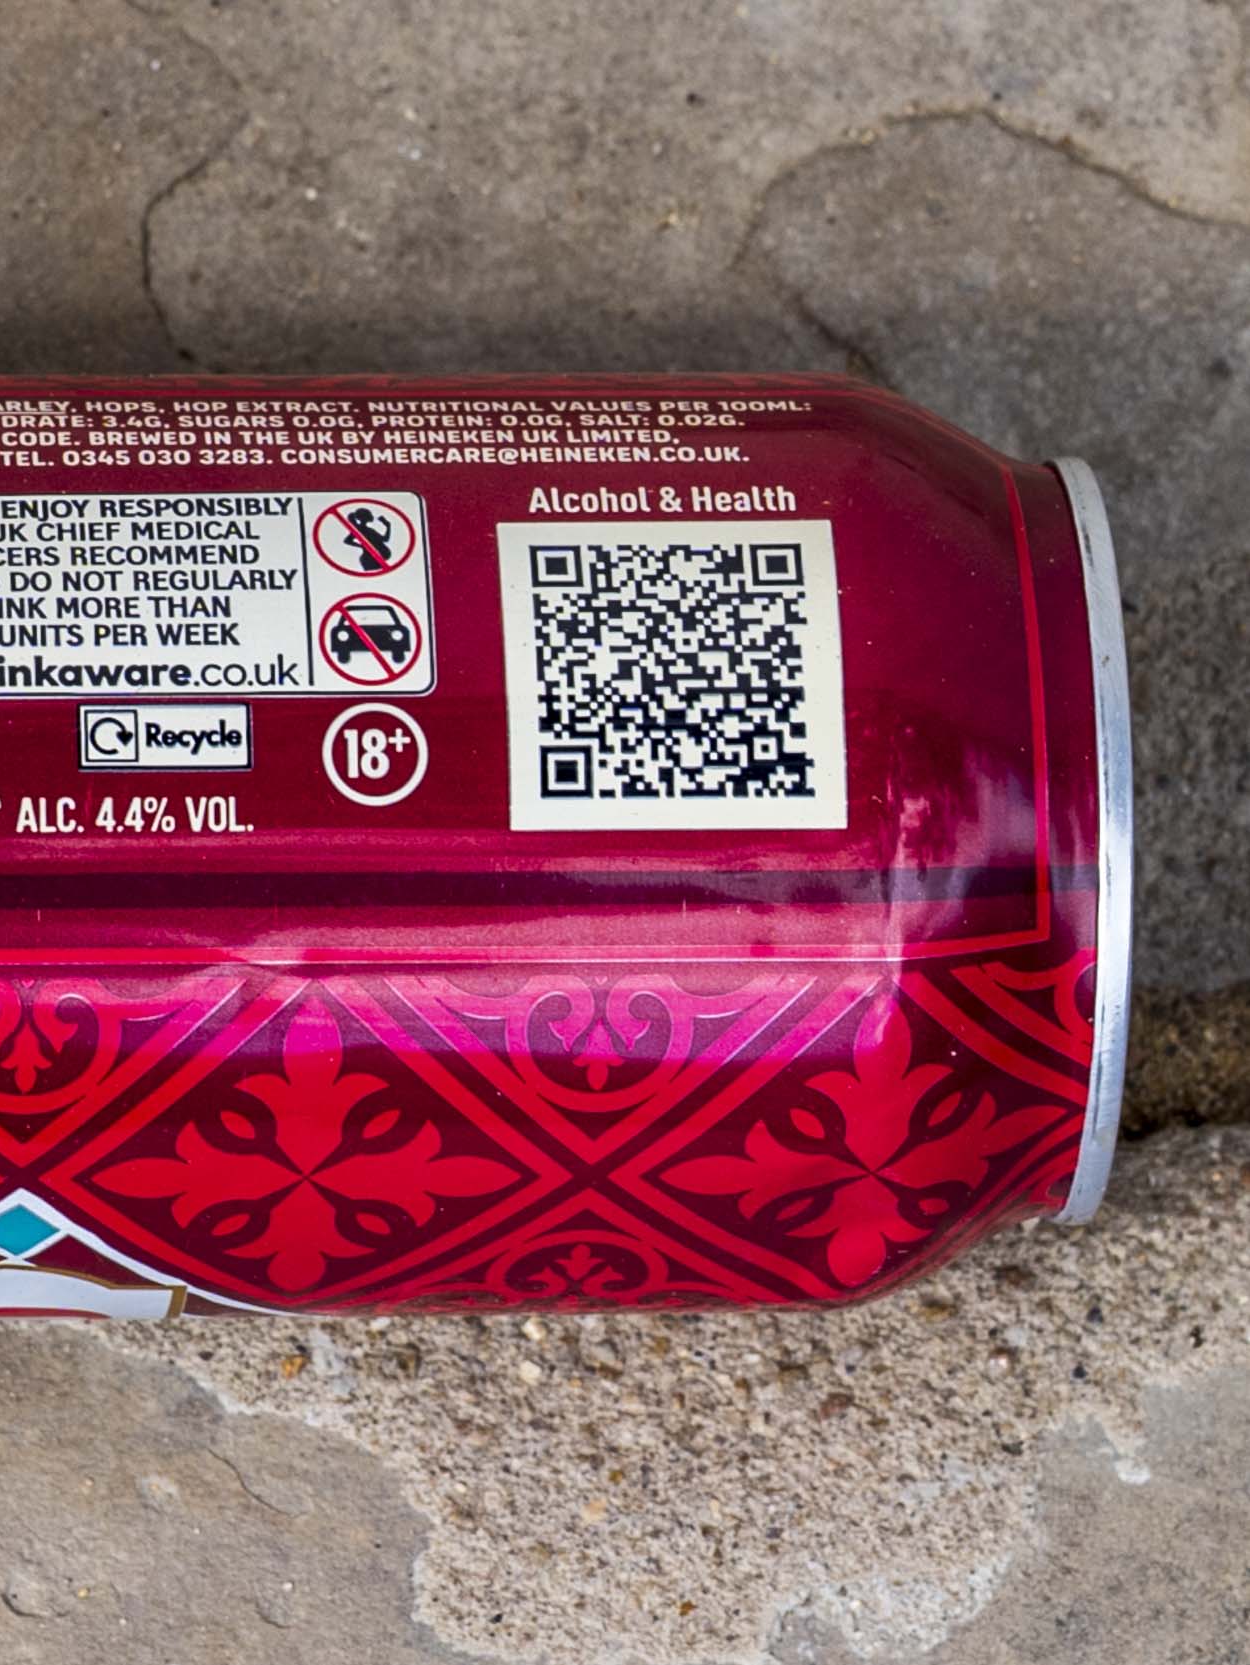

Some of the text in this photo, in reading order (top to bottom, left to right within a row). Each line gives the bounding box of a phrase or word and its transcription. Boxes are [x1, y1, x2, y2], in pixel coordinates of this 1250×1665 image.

[172, 401, 228, 412] HOP
[367, 401, 543, 412] NUTRITIONAL
[550, 401, 652, 412] VALUES
[659, 401, 709, 412] PER
[717, 400, 811, 412] 100ML:
[177, 415, 285, 428] SUGARS
[371, 415, 492, 427] PROTEIN:
[579, 414, 649, 426] SALT:
[1, 431, 80, 446] CODE.
[88, 431, 196, 446] BREWED
[203, 431, 231, 445] IN
[238, 431, 290, 445] THE
[297, 431, 333, 445] UK
[341, 430, 375, 445] BY
[383, 430, 514, 444] HEINEKEN
[521, 429, 559, 444] UK
[565, 429, 679, 444] LIMITED,
[61, 449, 131, 466] 0345
[137, 449, 191, 465] 030
[198, 449, 273, 465] 3283.
[280, 447, 749, 464] CONSUMERCARE@HEINEKEN.CO.UK.
[0, 499, 90, 523] ENJOY
[99, 497, 293, 518] RESPONSIBLY
[529, 485, 796, 513] Alcohol & Health
[41, 520, 121, 542] CHIEF
[130, 520, 260, 541] MEDICAL
[70, 544, 260, 566] RECOMMEND
[9, 570, 52, 593] DO
[62, 570, 123, 592] NOT
[133, 568, 298, 592] REGULARLY
[56, 596, 141, 619] MORE
[146, 595, 232, 619] THAN
[93, 623, 148, 647] PER
[155, 622, 240, 646] WEEK
[145, 721, 243, 753] Recycle
[343, 725, 415, 782] 18+
[16, 796, 84, 833] ALC.
[95, 796, 176, 833] 4.4%
[185, 796, 254, 833] VOL.
